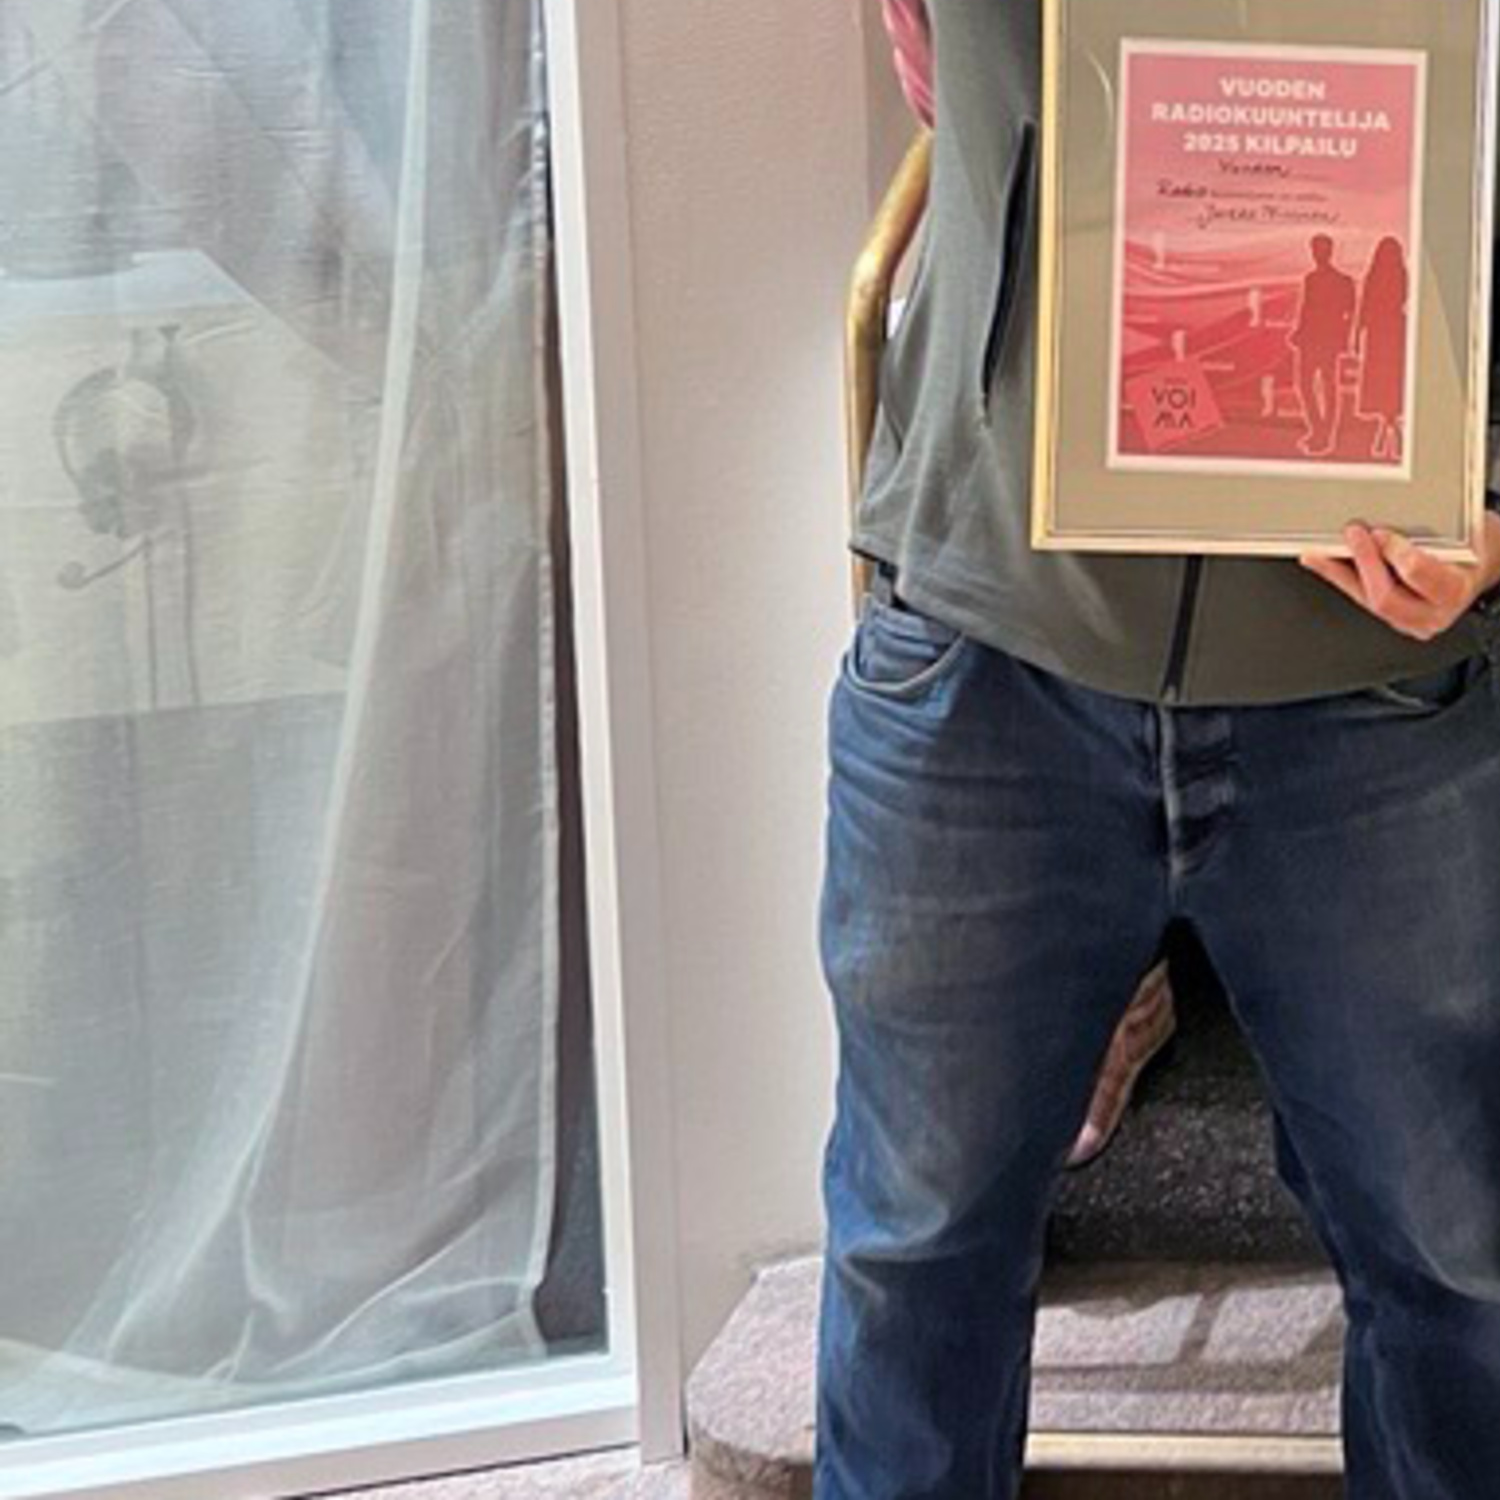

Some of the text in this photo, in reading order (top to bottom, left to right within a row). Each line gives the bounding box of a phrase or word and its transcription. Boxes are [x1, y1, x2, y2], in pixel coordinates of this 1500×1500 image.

[1220, 77, 1326, 100] VUODEN
[1151, 103, 1391, 131] RADIOKUUNTELIJA
[1183, 133, 1358, 157] 2025 KILPAILU
